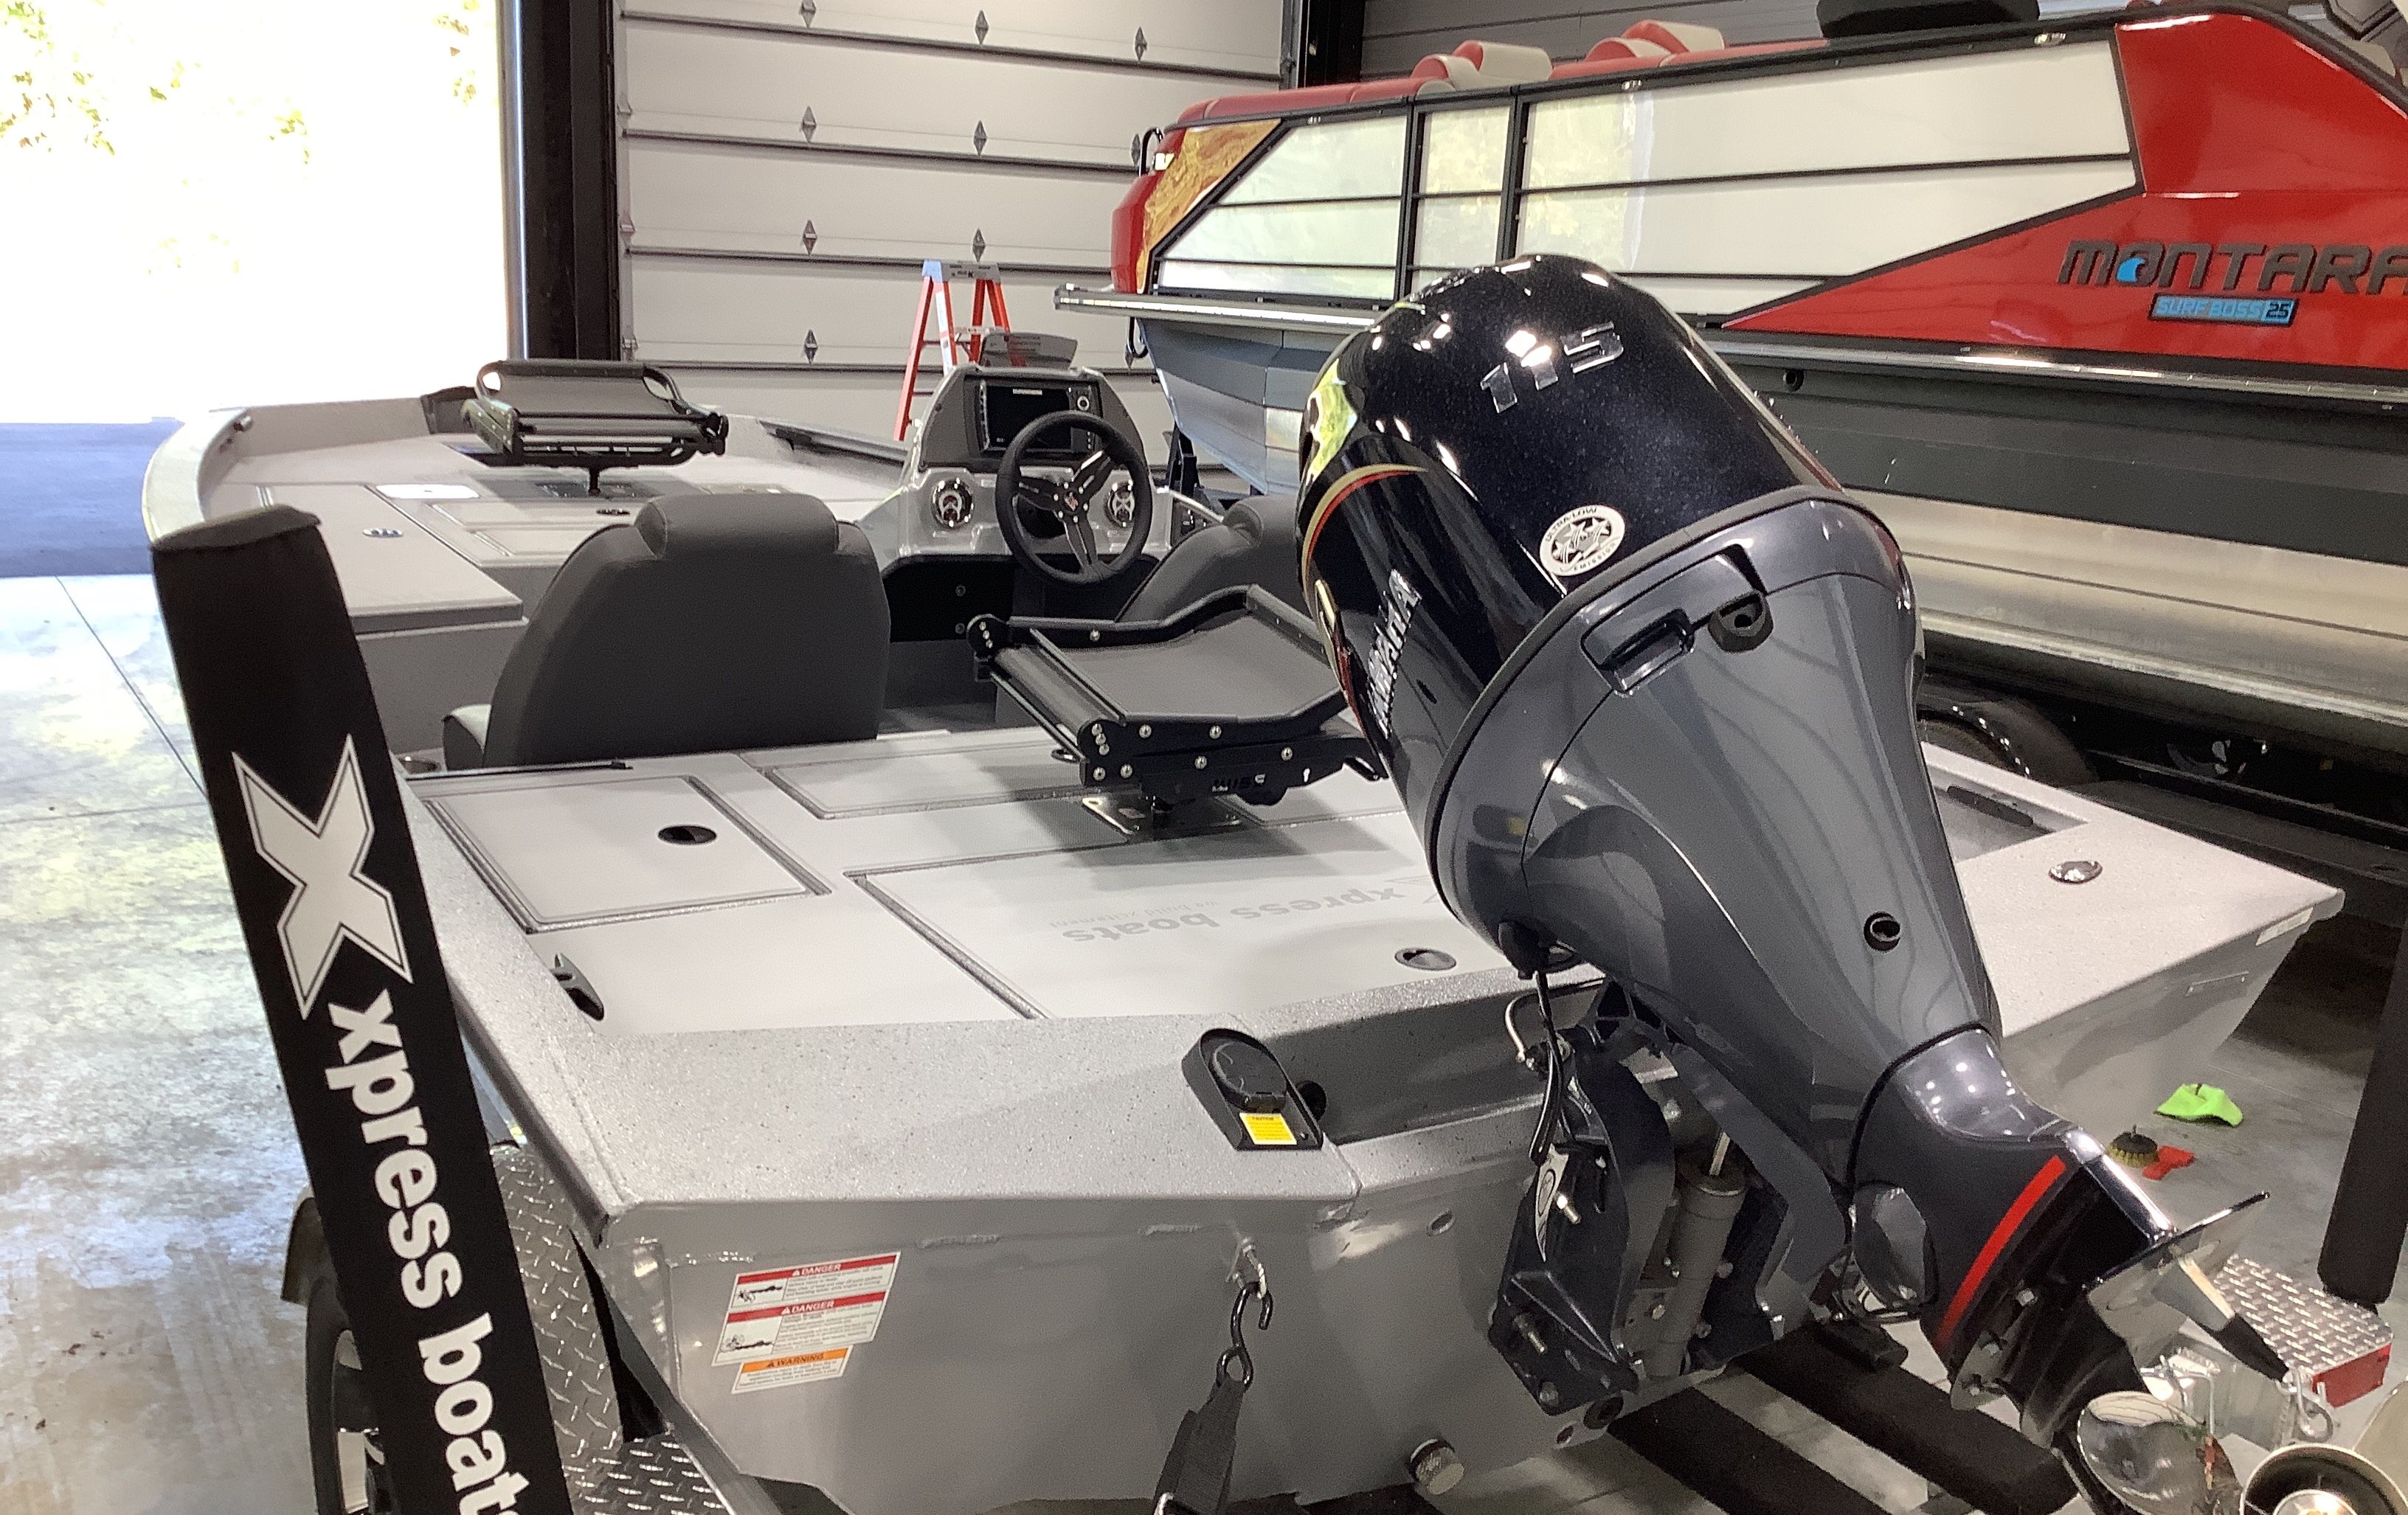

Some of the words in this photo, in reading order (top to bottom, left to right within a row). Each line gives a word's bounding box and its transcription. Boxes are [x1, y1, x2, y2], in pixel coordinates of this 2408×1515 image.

[2156, 297, 2207, 316] SURF
[2209, 299, 2262, 318] BOSS
[2266, 300, 2291, 319] 25
[1480, 321, 1624, 413] 115
[1230, 887, 1406, 919] xpress
[1062, 913, 1221, 941] boats
[325, 988, 464, 1310] xpress
[418, 1312, 530, 1515] boat
[800, 1263, 842, 1276] DANGER
[791, 1300, 835, 1314] DANGER
[777, 1353, 825, 1367] WARNING
